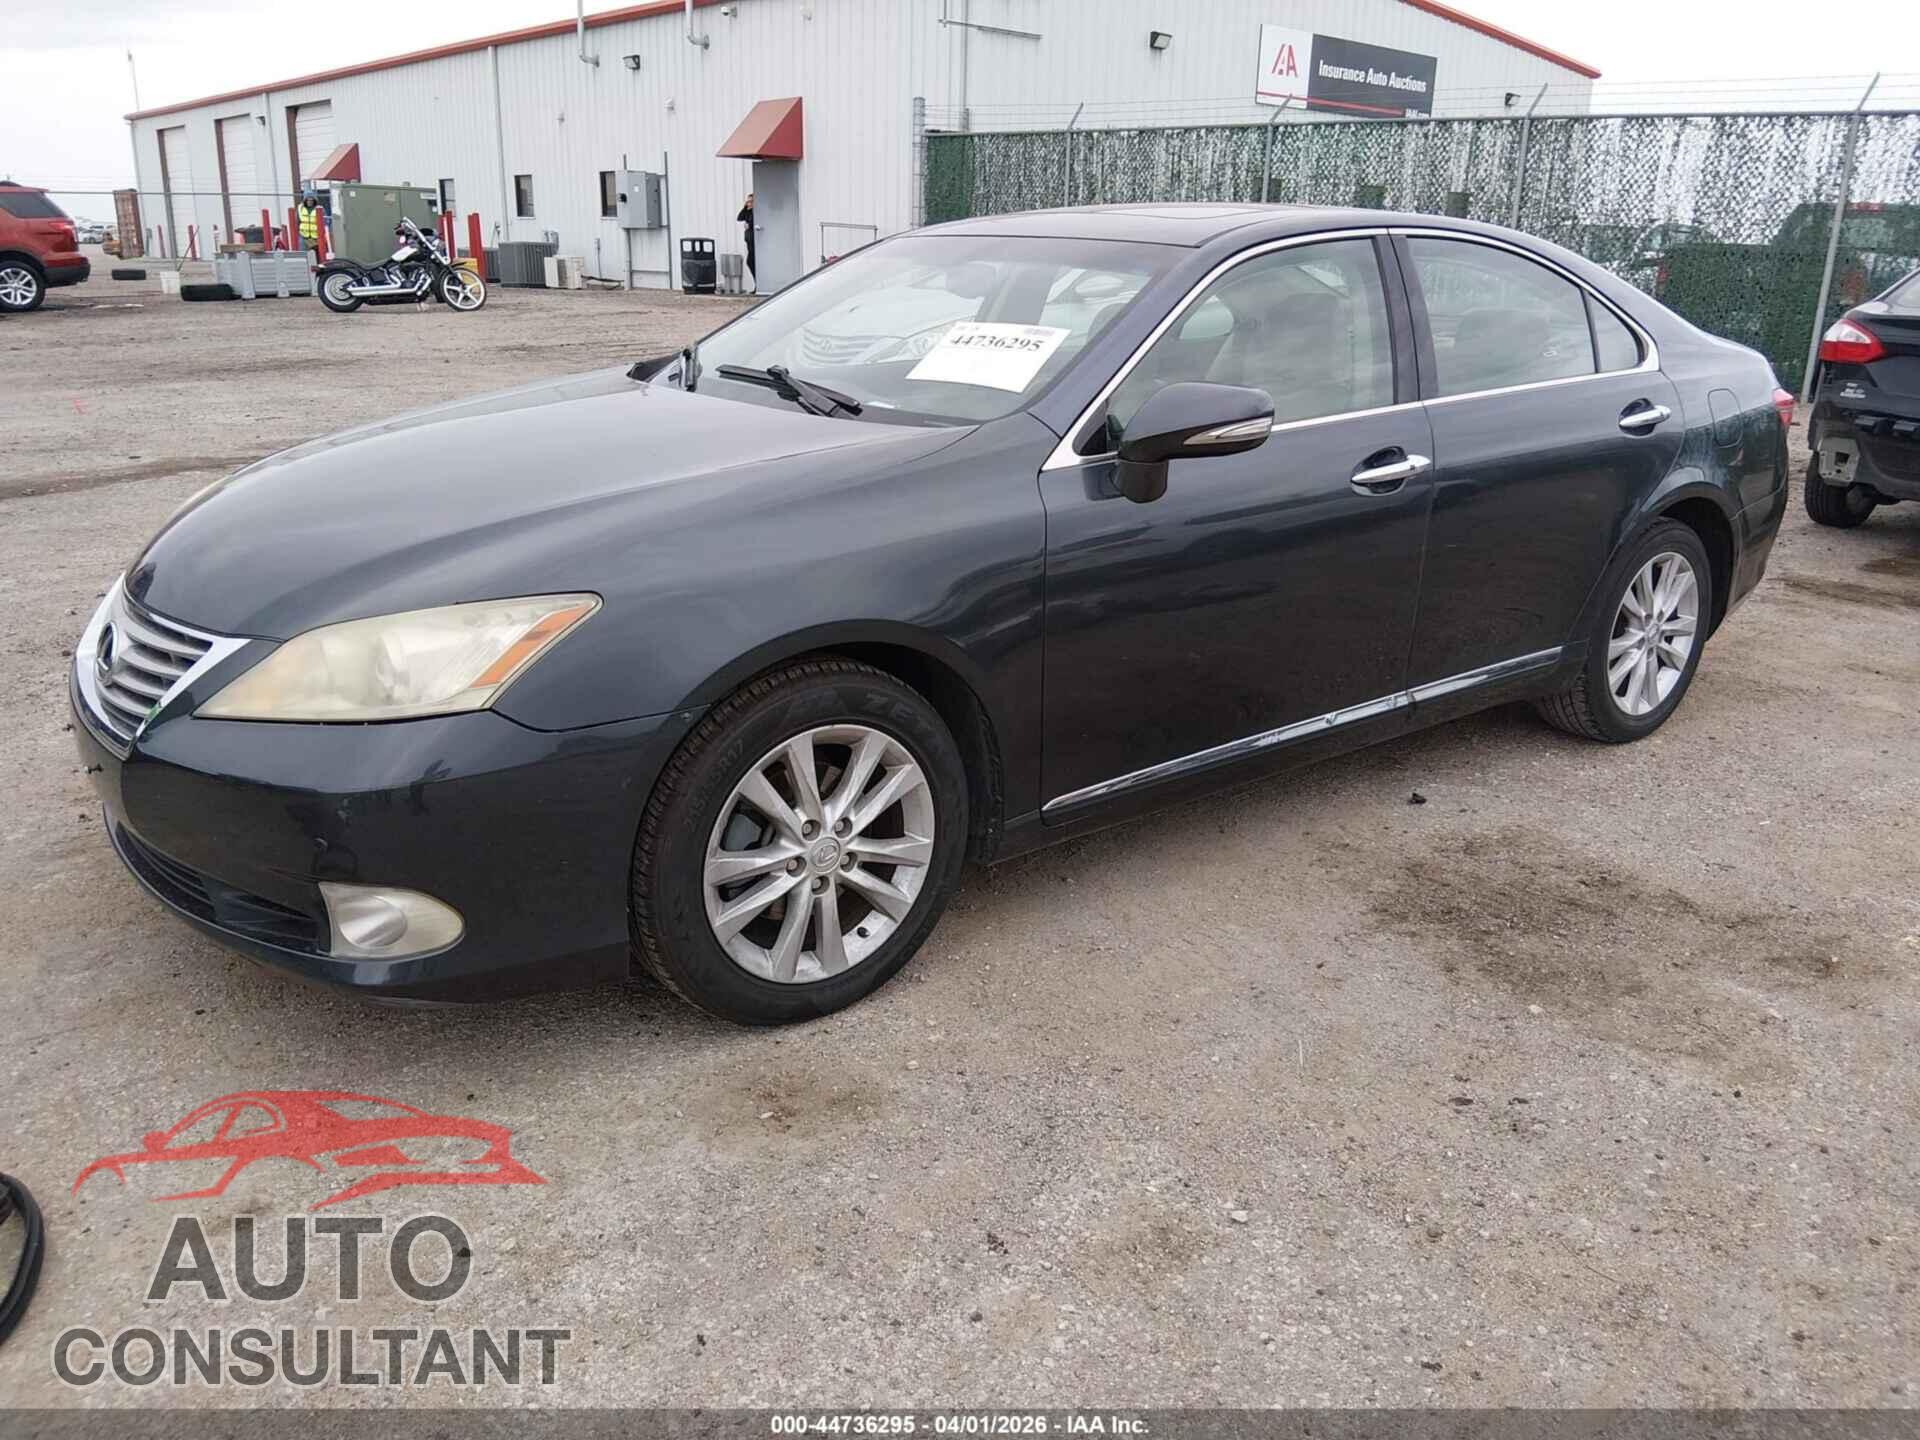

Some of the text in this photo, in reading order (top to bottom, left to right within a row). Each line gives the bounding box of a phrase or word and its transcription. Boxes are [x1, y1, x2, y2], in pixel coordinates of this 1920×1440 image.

[1318, 59, 1428, 93] Insurance Auto Auctions
[950, 335, 1045, 352] 44736295
